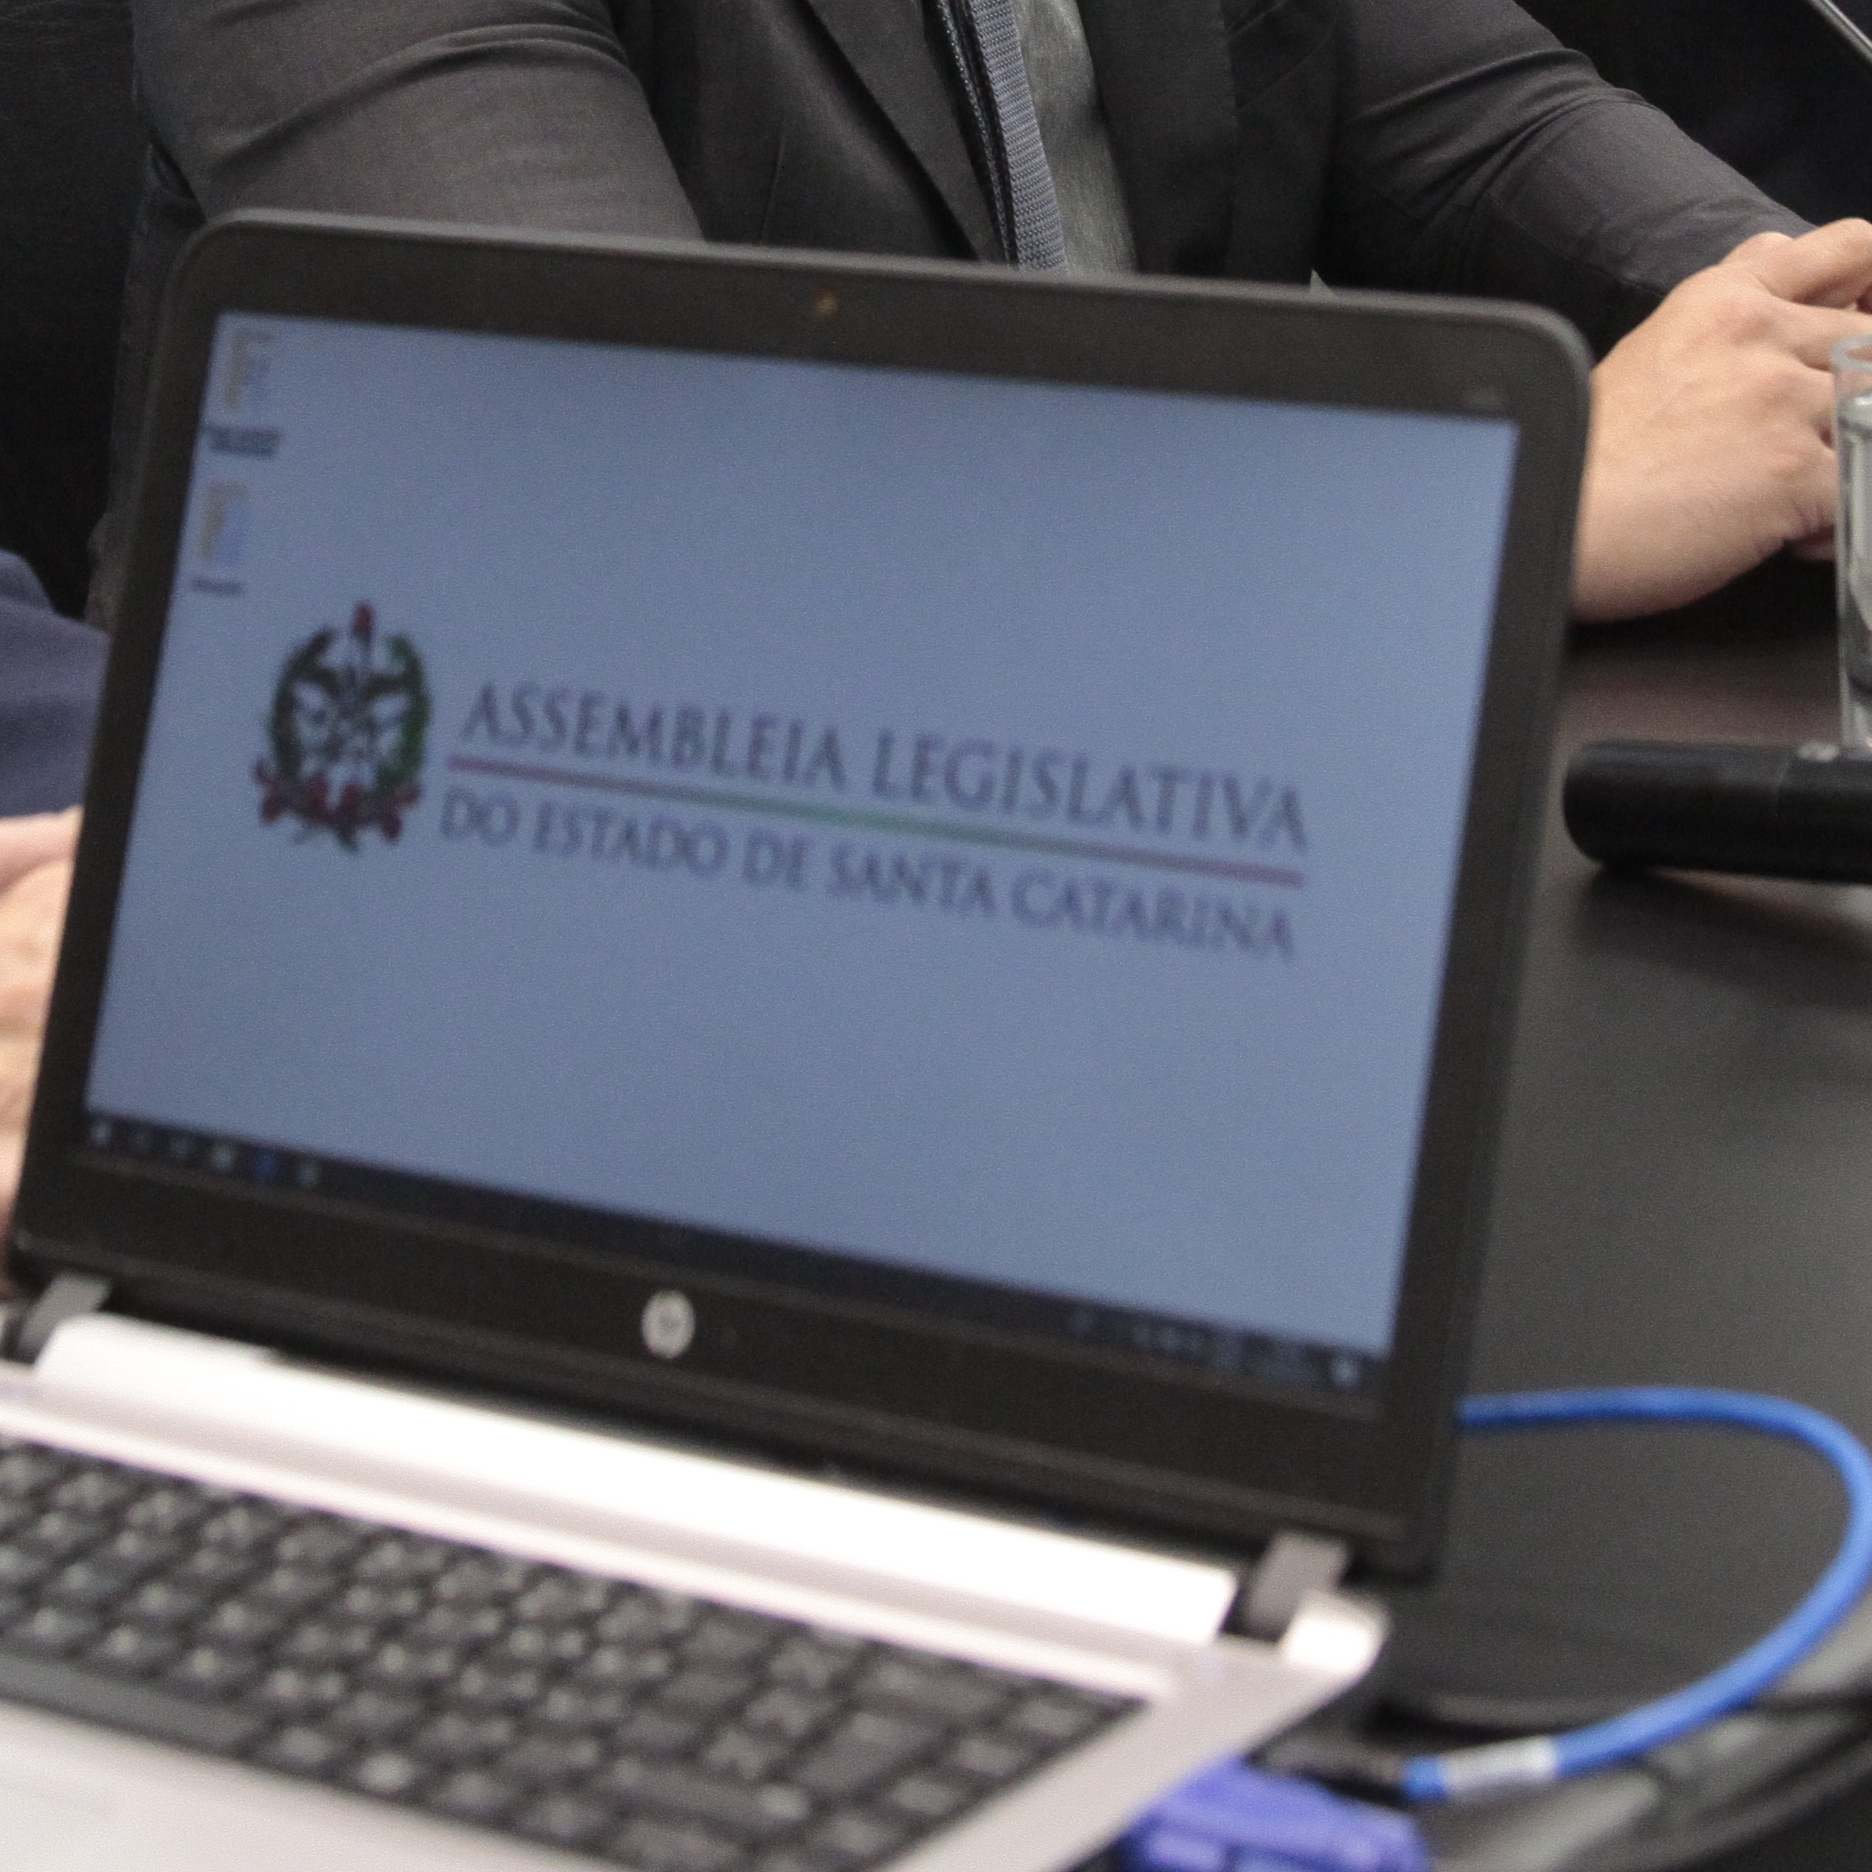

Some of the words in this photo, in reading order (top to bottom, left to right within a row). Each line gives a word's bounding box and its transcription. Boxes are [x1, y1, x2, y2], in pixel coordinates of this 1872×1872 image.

[465, 681, 848, 792] ASSEMBLEIA
[871, 731, 1308, 850] LEGISLATIVA
[439, 786, 518, 846] DO
[534, 801, 727, 880] ESTADO
[742, 828, 808, 890] DE
[830, 848, 995, 924] SANTA
[1011, 871, 1295, 961] CATARINA
